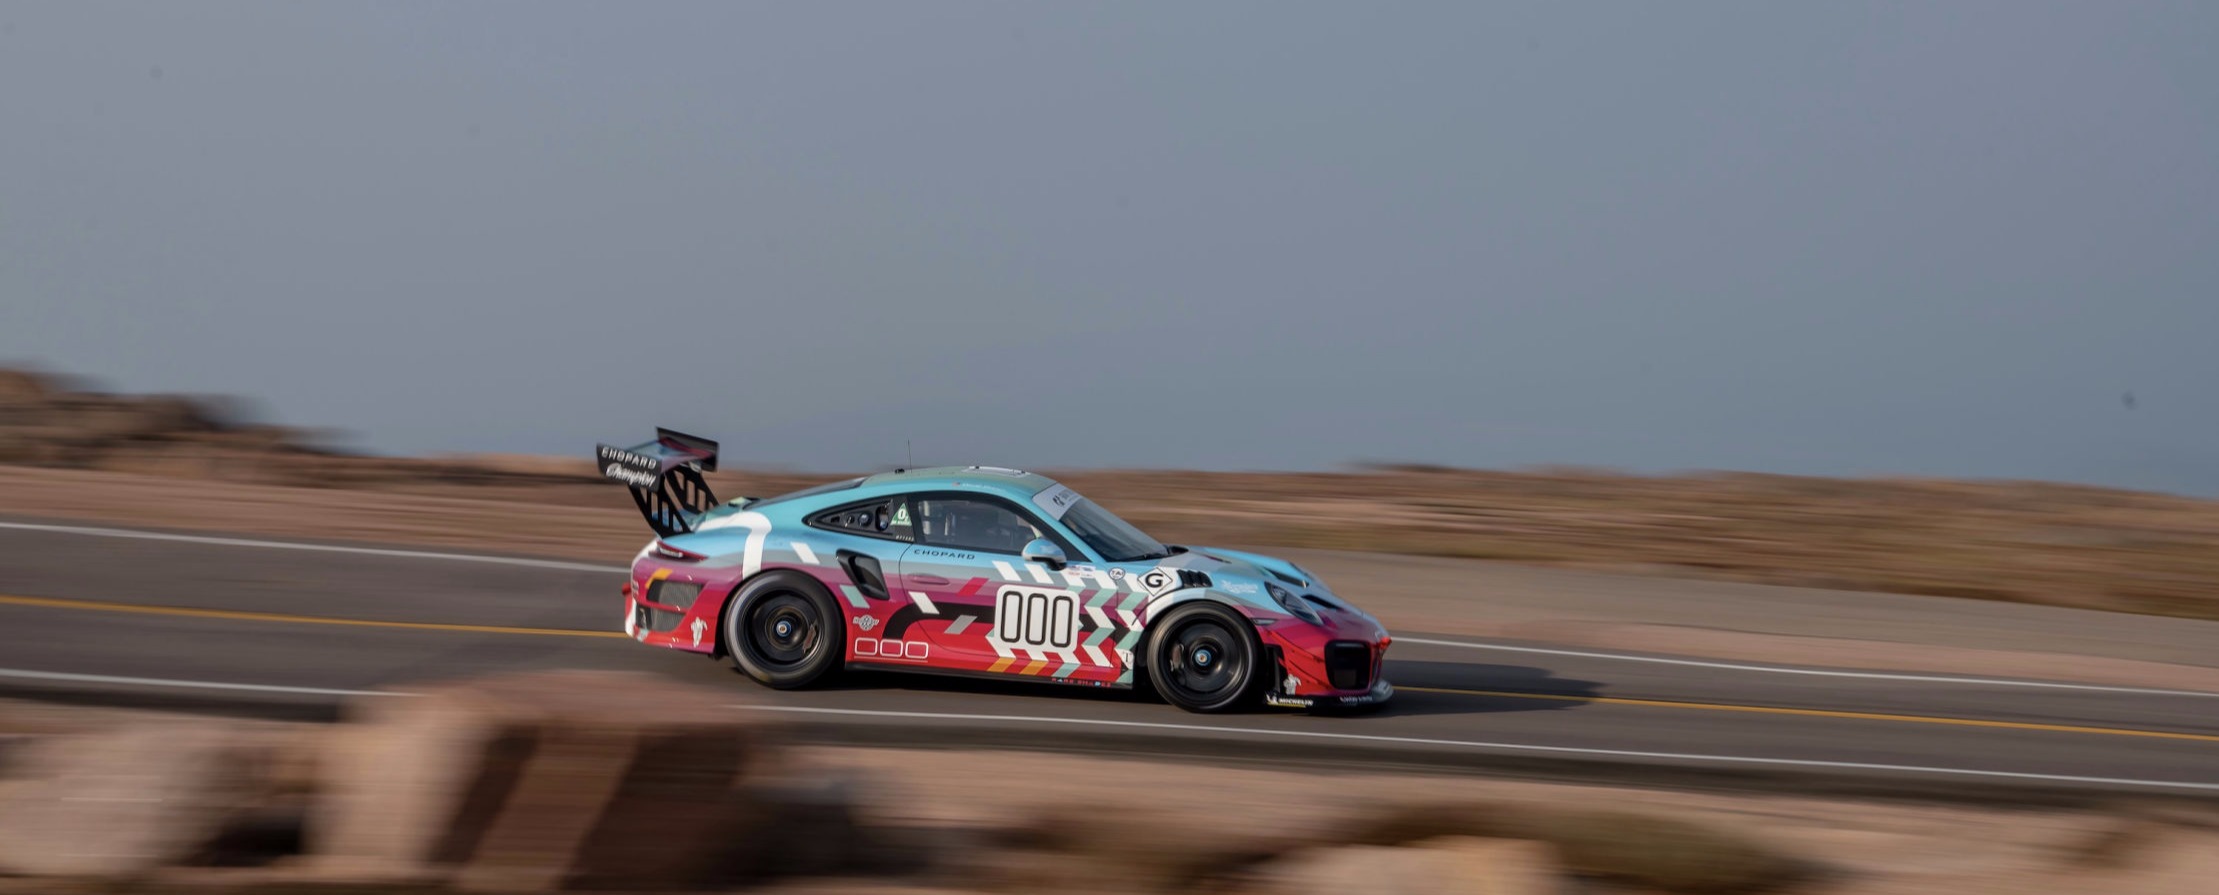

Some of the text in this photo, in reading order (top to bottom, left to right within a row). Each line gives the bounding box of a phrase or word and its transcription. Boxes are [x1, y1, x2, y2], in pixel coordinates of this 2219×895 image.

[914, 549, 976, 560] CHOPARD
[1145, 573, 1164, 588] G
[1000, 590, 1074, 648] 000
[1279, 698, 1314, 706] MICHELIN
